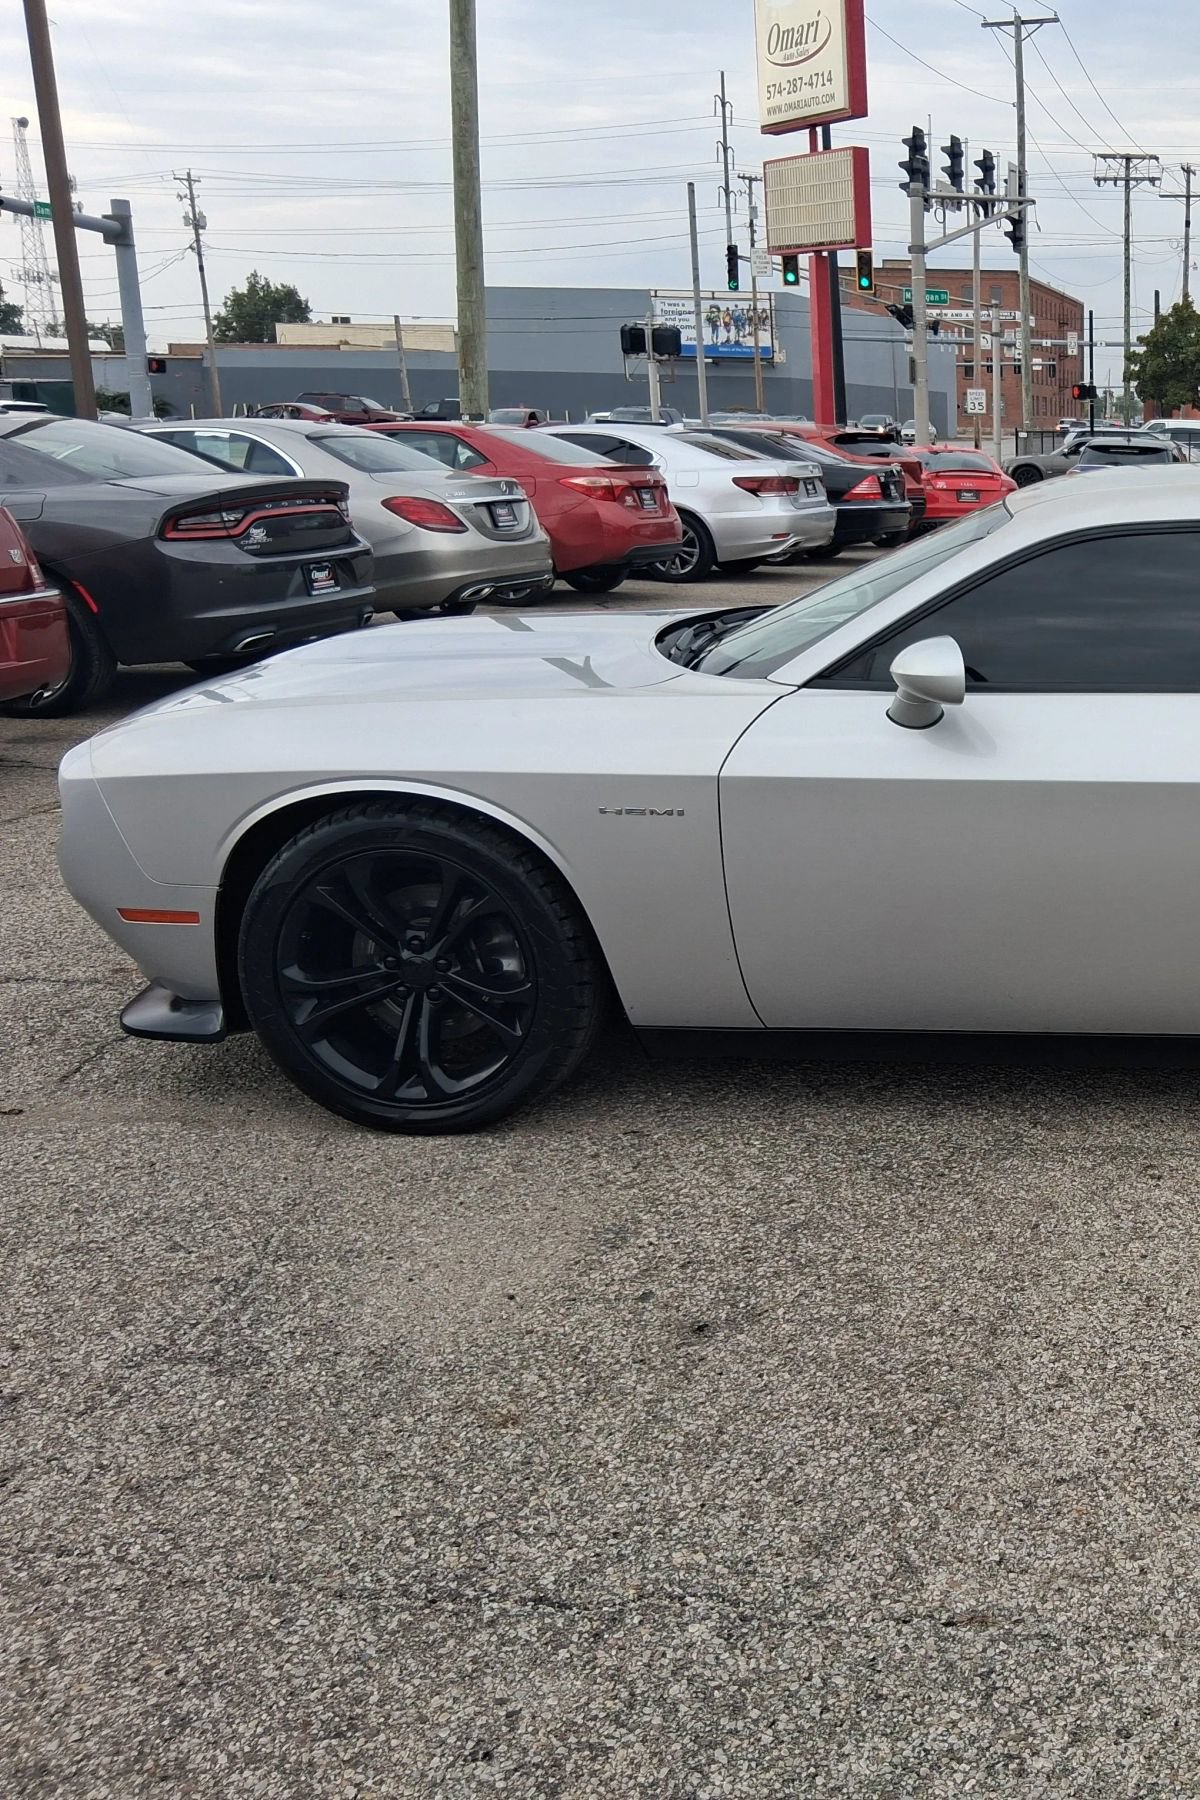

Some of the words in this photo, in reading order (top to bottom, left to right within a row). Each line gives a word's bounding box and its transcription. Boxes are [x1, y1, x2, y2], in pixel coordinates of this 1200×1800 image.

[767, 9, 821, 56] Omari
[783, 51, 796, 62] Auto
[796, 46, 811, 59] Sales
[766, 69, 833, 100] 574-287-4714
[766, 92, 836, 117] WWW.OMARIAUTO.COM
[661, 308, 696, 316] foreigner
[969, 402, 985, 411] 35
[598, 806, 685, 817] HEMI
